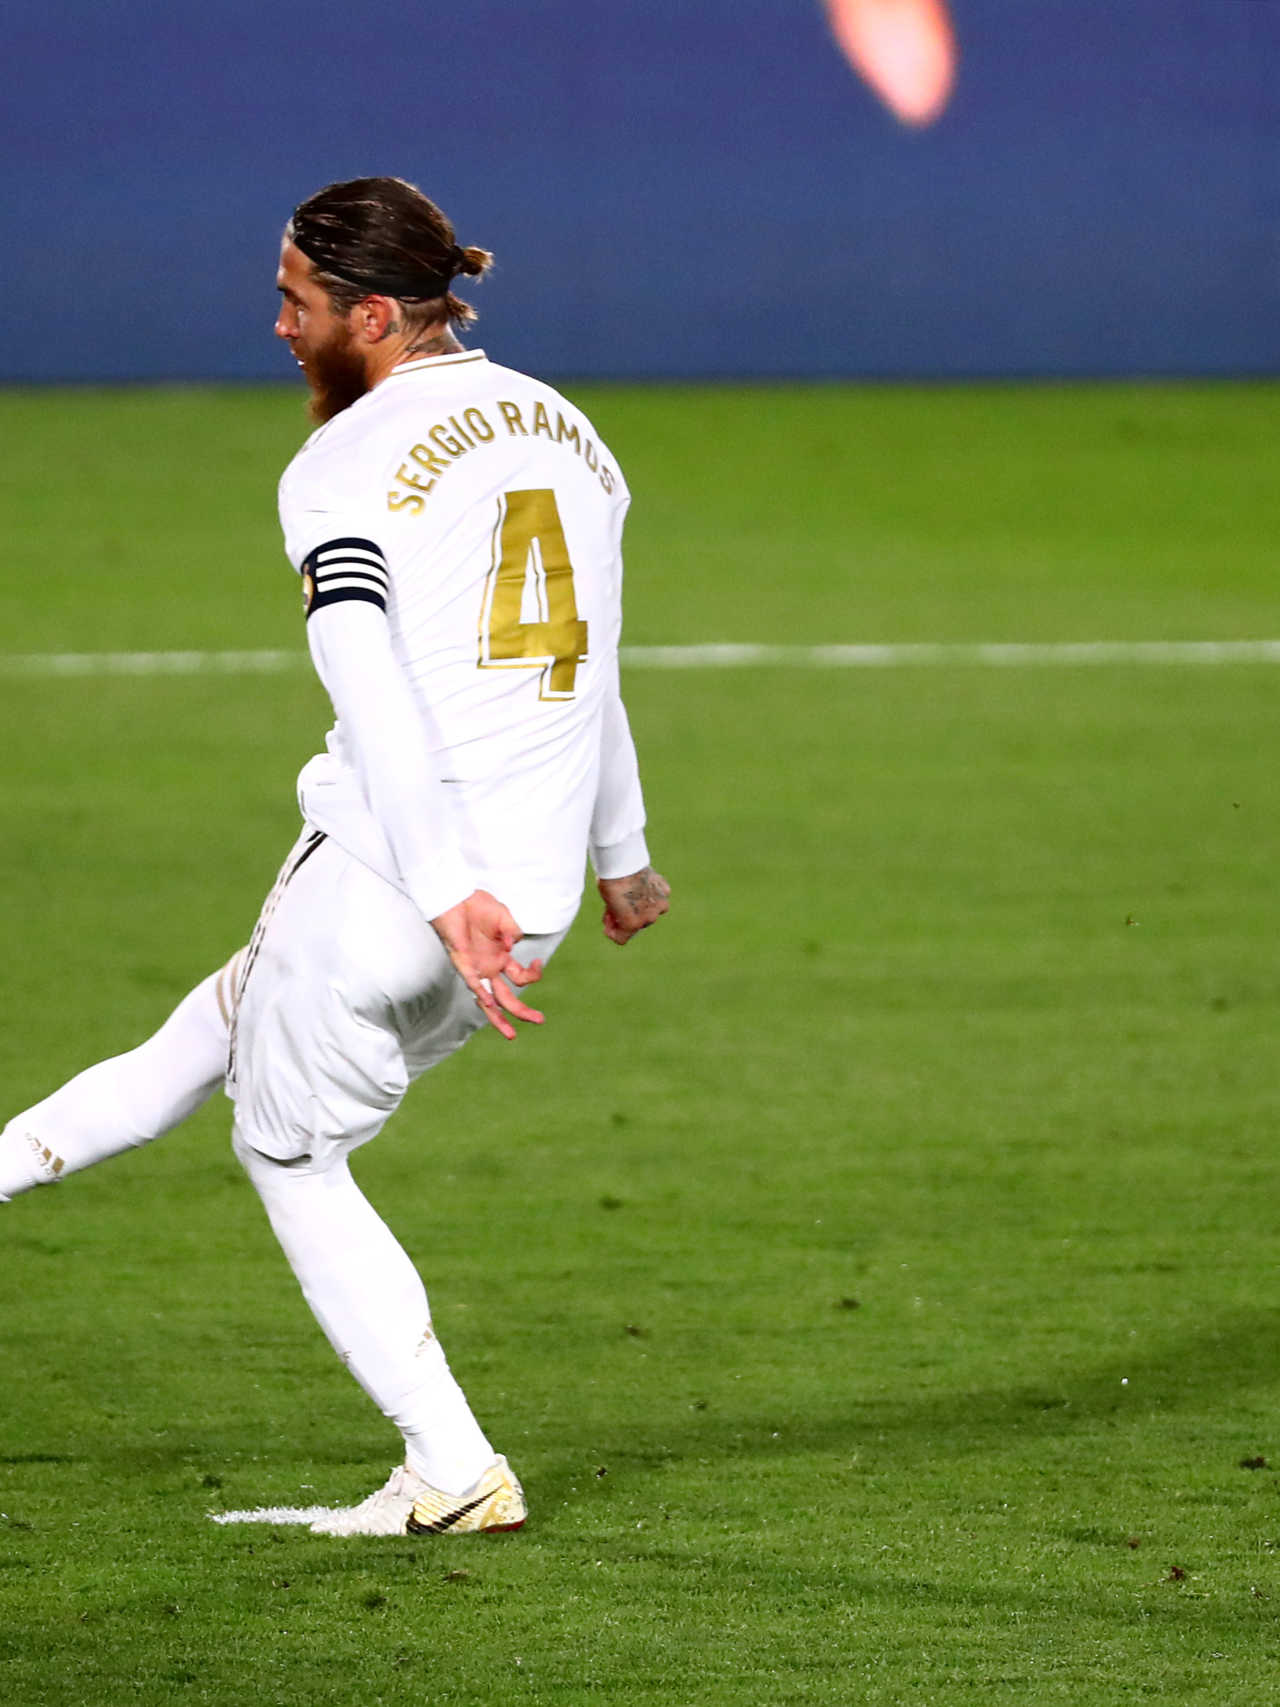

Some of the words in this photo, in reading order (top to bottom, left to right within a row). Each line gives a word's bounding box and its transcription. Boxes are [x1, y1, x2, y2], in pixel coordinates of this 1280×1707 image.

[387, 407, 495, 516] SERGIO
[497, 401, 617, 495] RAMOS
[478, 488, 588, 701] 4
